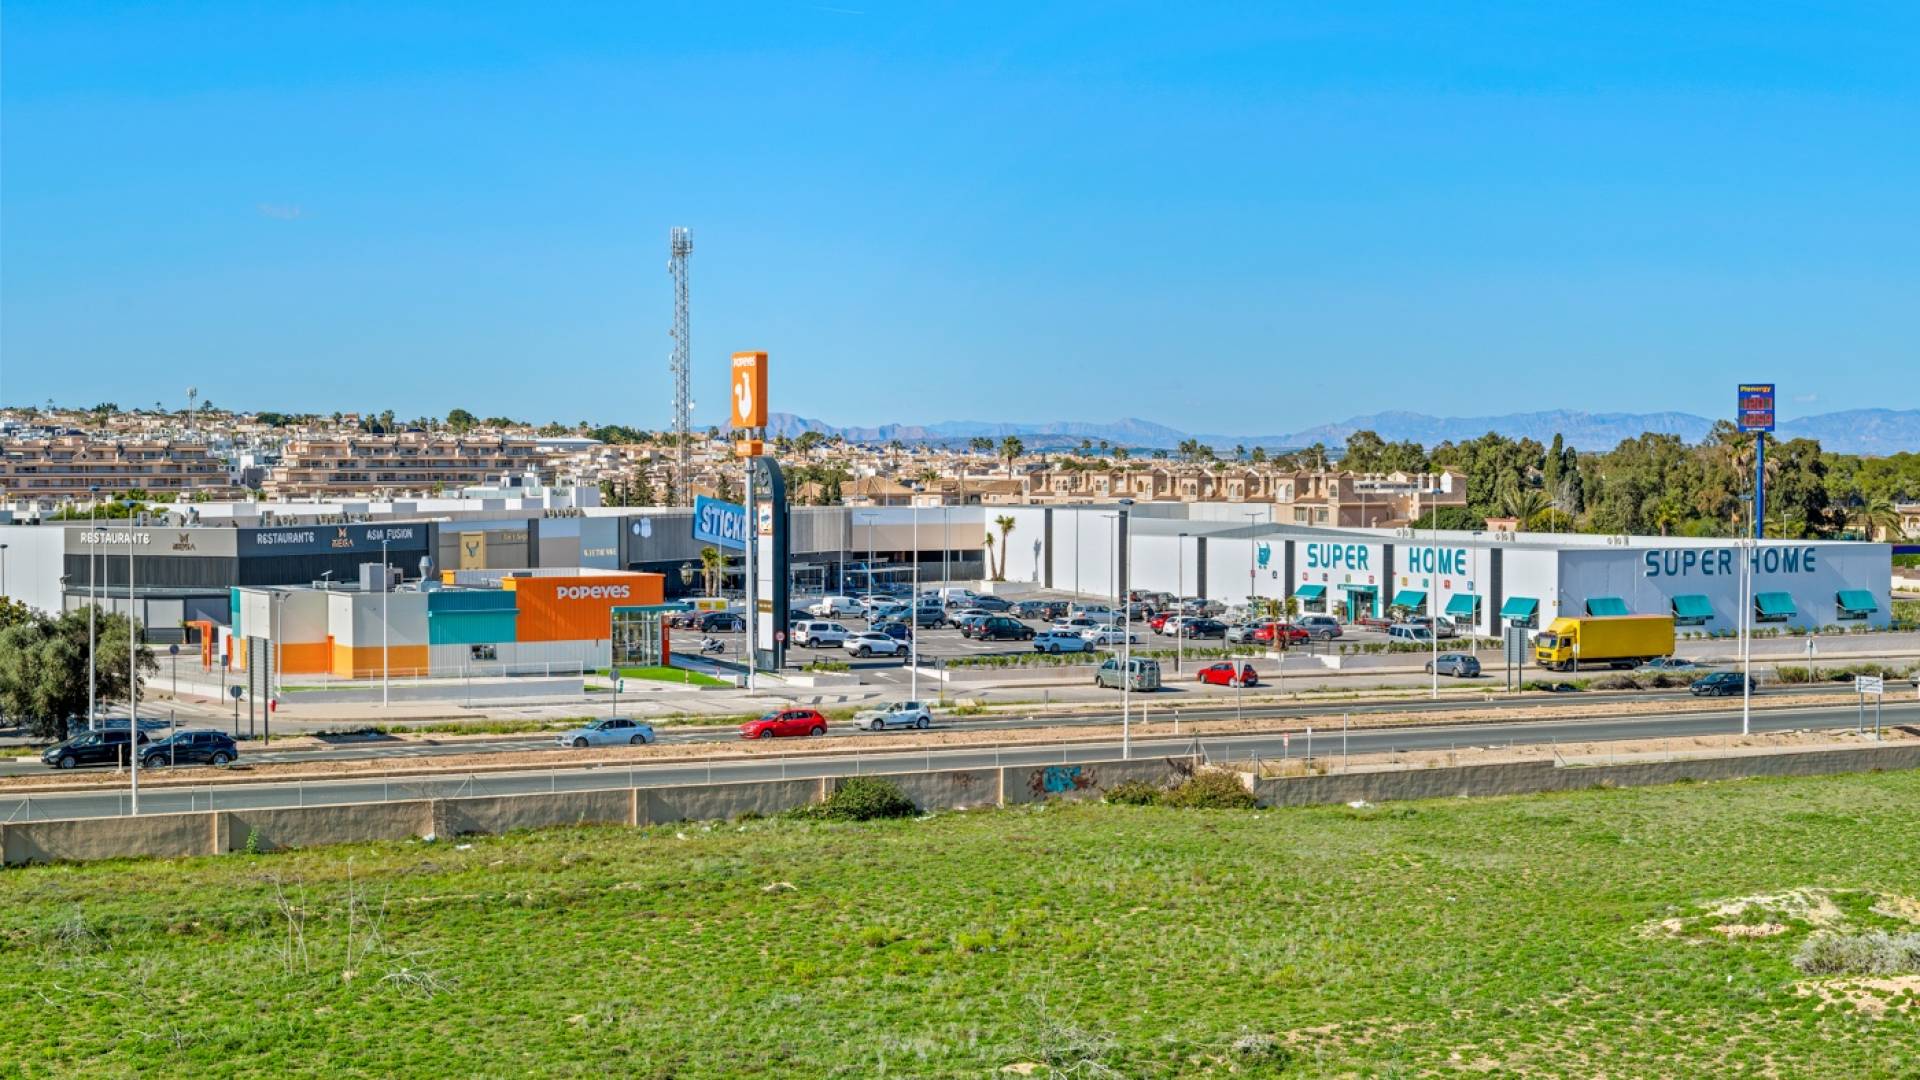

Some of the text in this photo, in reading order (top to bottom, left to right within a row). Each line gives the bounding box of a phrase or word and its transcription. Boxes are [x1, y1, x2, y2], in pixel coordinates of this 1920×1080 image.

[80, 532, 151, 545] RESTAURANTE
[257, 531, 315, 545] RESTAURANTE
[366, 528, 413, 540] ASIA FUSION
[1307, 543, 1467, 575] SUPER HOME
[1644, 549, 1733, 577] SUPER
